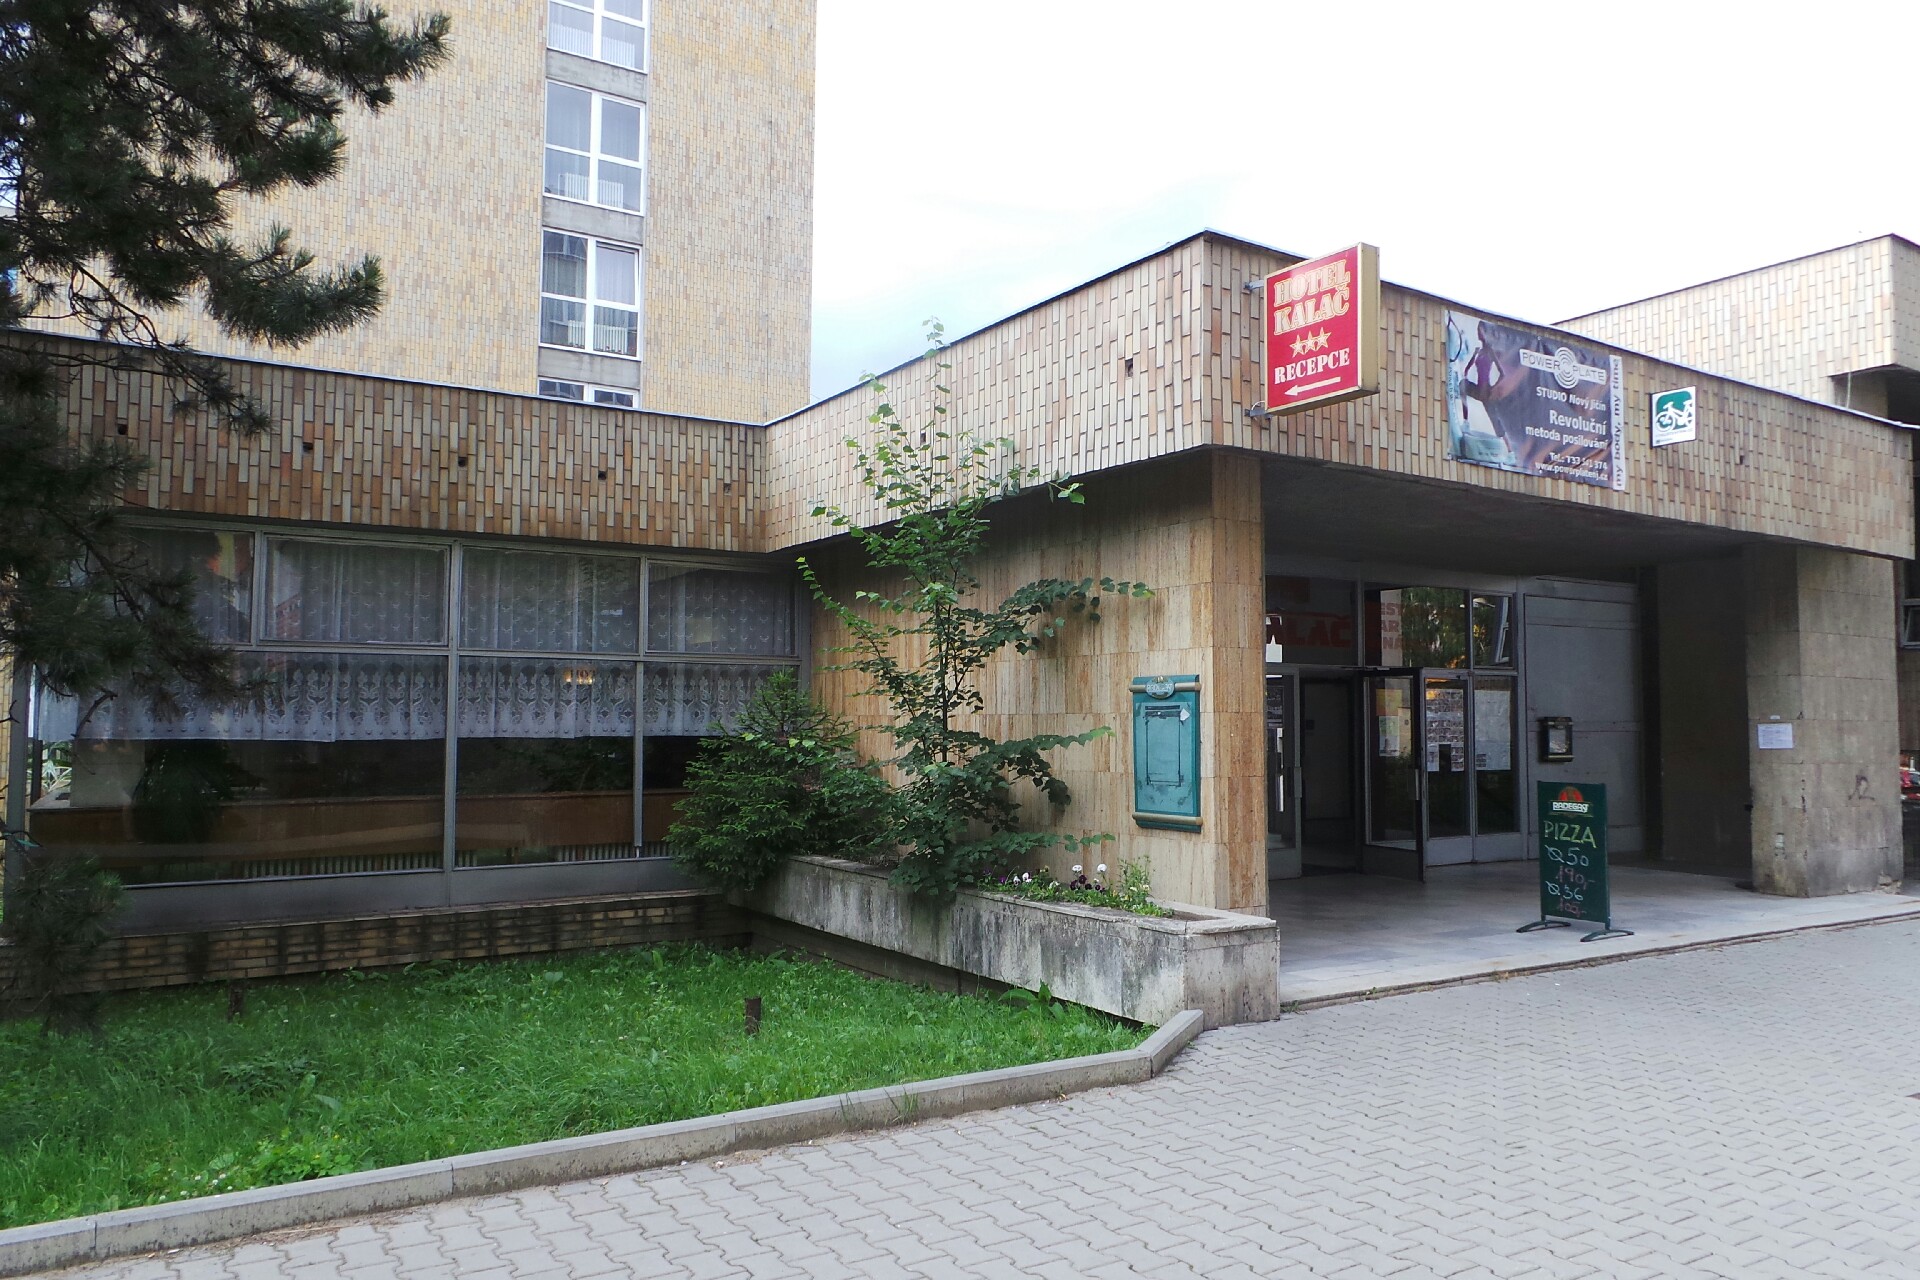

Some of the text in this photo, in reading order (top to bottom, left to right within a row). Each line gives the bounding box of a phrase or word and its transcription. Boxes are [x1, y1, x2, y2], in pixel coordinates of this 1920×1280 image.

[1274, 259, 1350, 307] HOTEL
[1274, 282, 1350, 336] KALAČ
[1274, 348, 1350, 384] RECEPCE
[1522, 352, 1605, 382] POWER PLATE
[1536, 386, 1568, 402] STUDIO
[1569, 394, 1589, 409] Nový
[1614, 395, 1620, 416] my
[1549, 409, 1607, 436] Revoluční
[1525, 426, 1608, 450] metoda posilování
[1552, 801, 1589, 813] RADEGAST
[1544, 821, 1596, 848] PIZZA
[1566, 847, 1589, 867] 50
